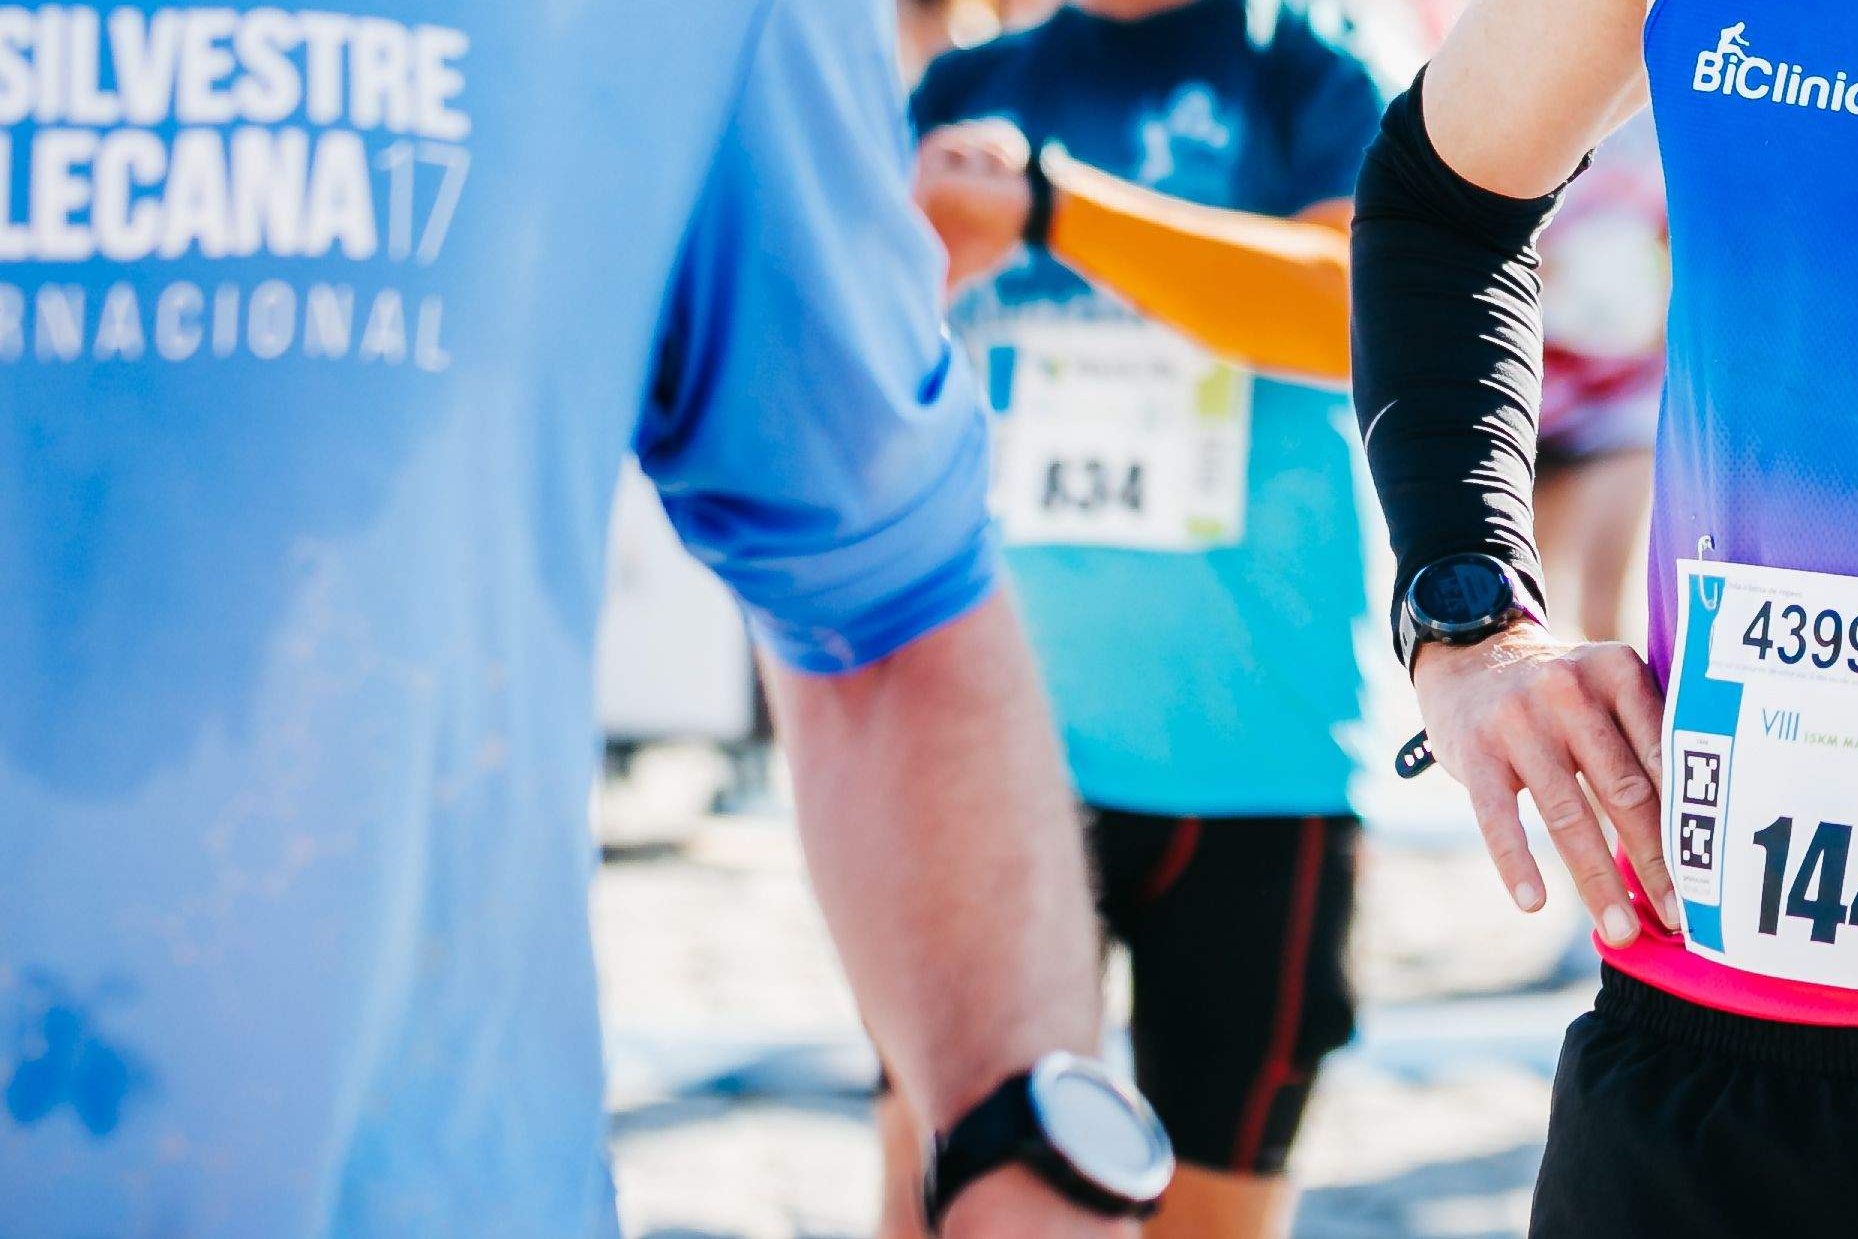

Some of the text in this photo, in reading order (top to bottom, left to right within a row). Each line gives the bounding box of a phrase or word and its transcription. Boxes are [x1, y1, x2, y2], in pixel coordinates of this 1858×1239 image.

[0, 5, 470, 140] SILVESTRE
[377, 144, 471, 268] 17
[1761, 707, 1801, 741] VIII
